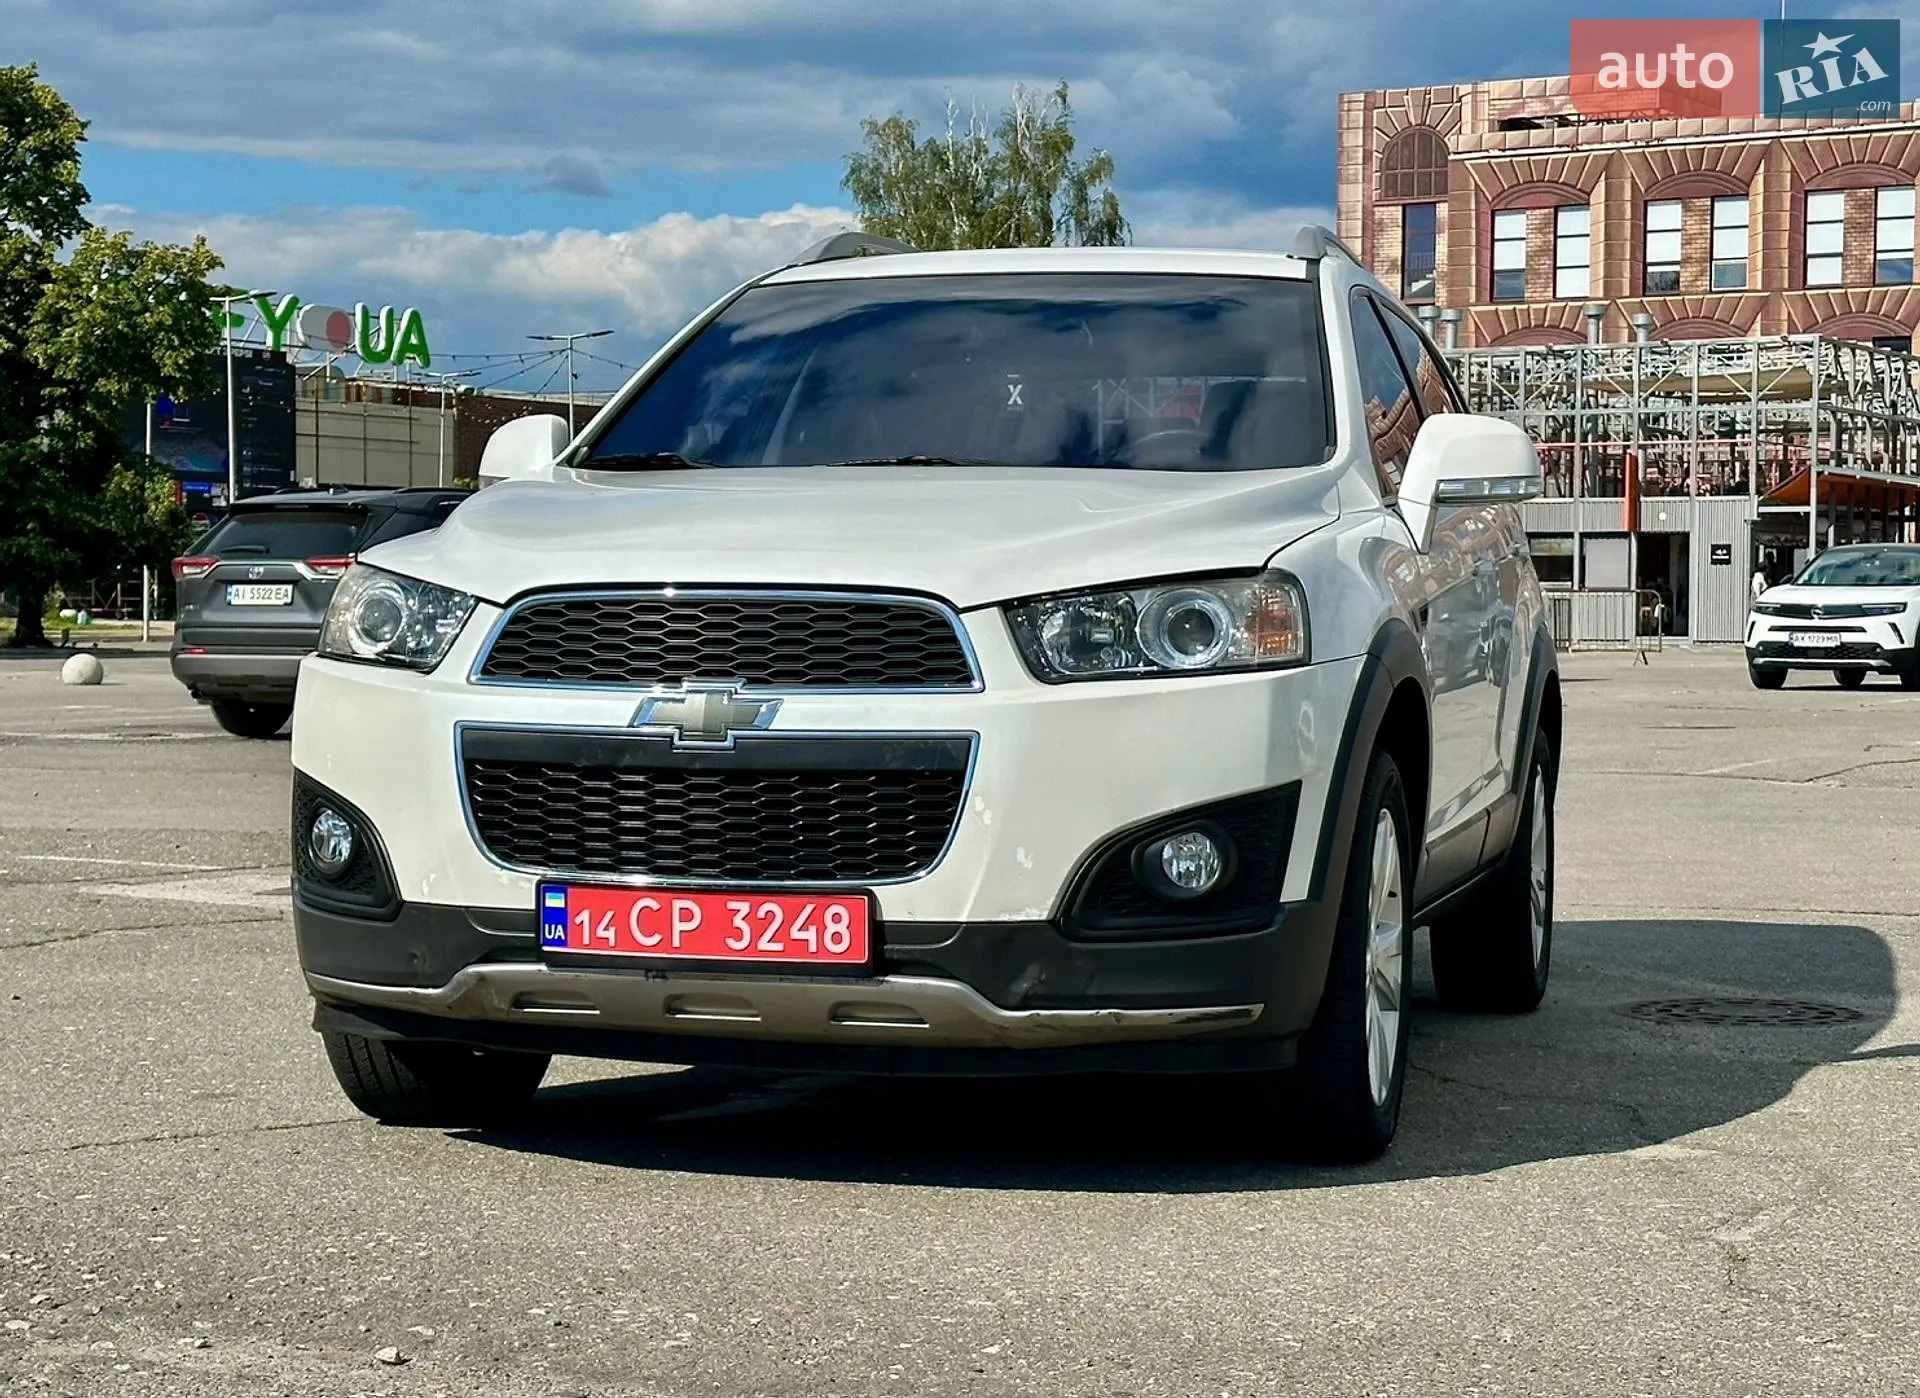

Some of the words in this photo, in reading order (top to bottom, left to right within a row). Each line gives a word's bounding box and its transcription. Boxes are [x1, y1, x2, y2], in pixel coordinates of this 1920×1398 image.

[545, 922, 565, 940] UA
[573, 908, 617, 948] 14
[629, 897, 704, 949] CP
[724, 900, 852, 955] 3248
